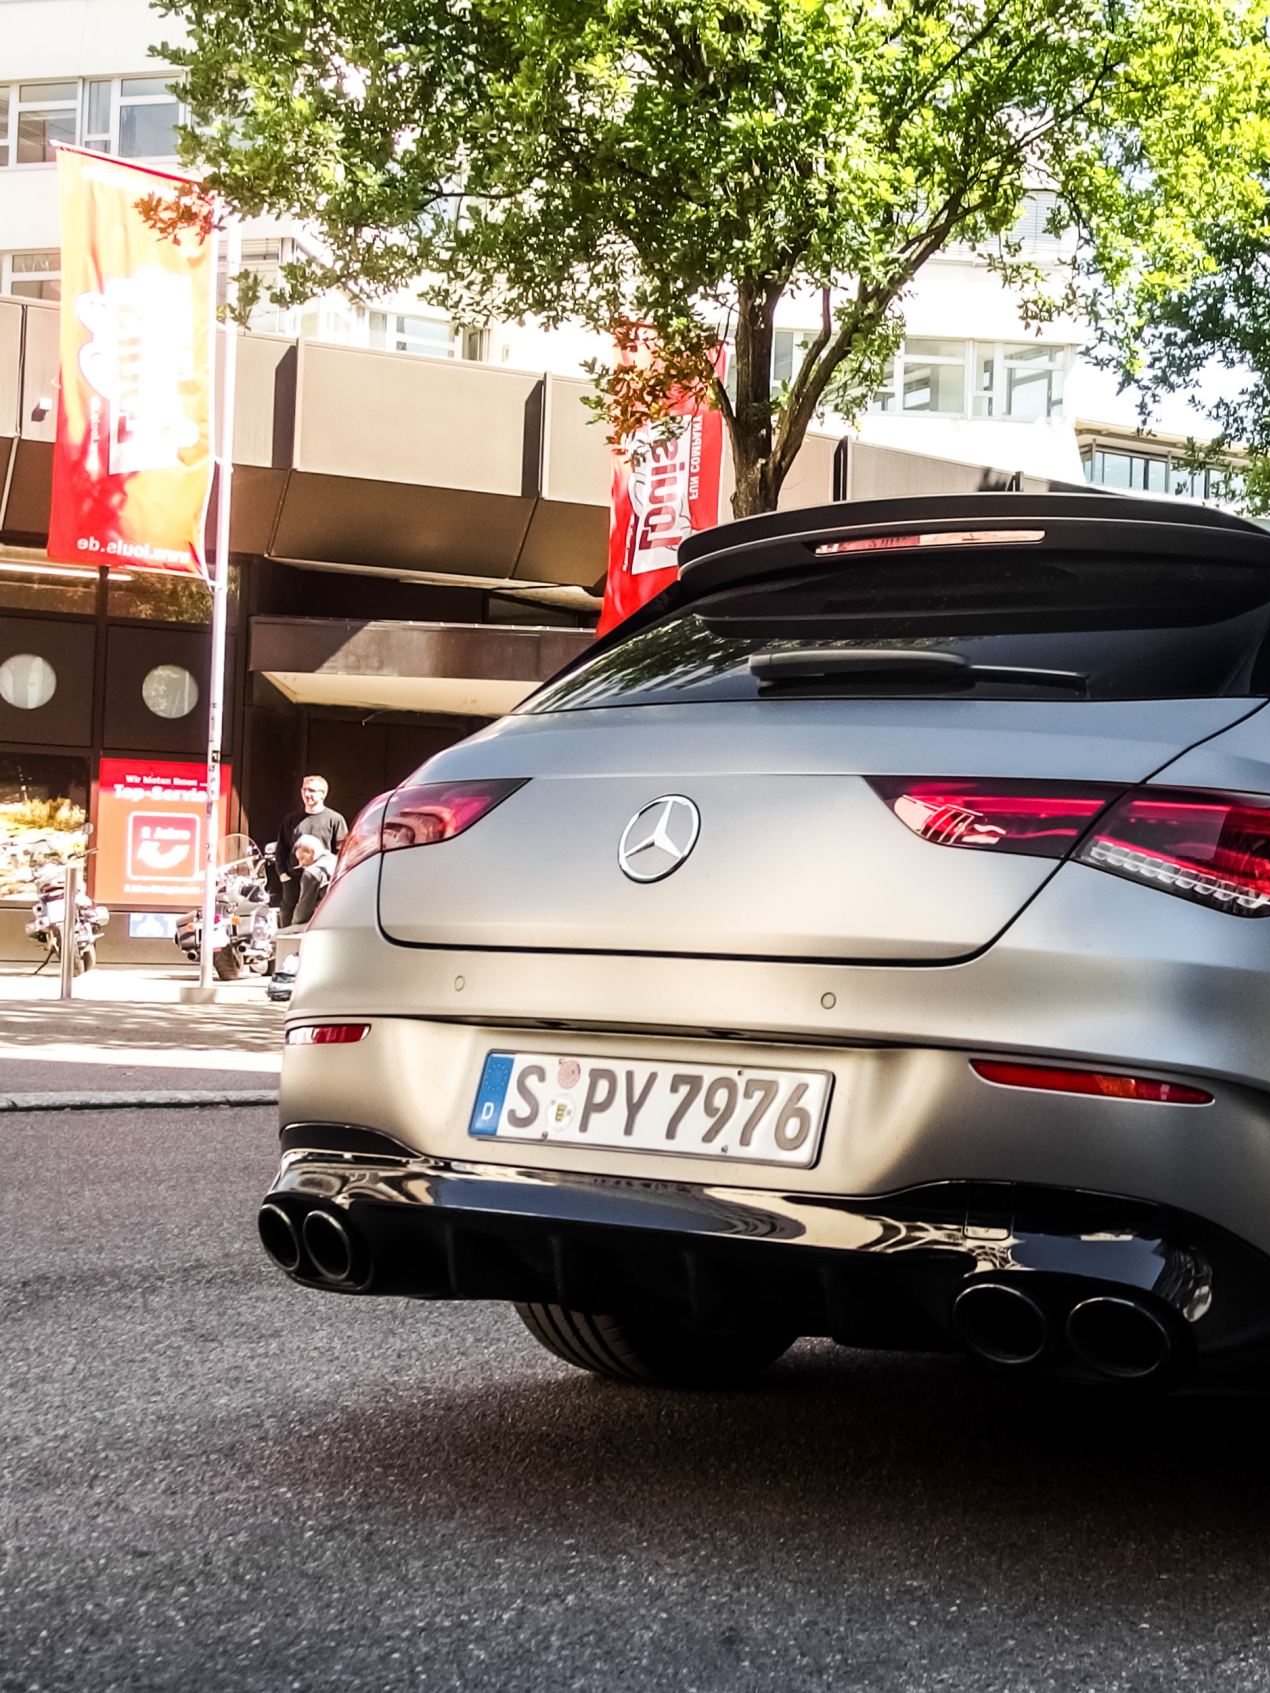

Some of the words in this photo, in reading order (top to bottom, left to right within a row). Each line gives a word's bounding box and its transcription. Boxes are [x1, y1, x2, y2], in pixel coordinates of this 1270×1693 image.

[480, 1102, 494, 1121] D
[507, 1065, 546, 1129] S
[578, 1068, 659, 1137] PY
[665, 1073, 812, 1152] 7976
